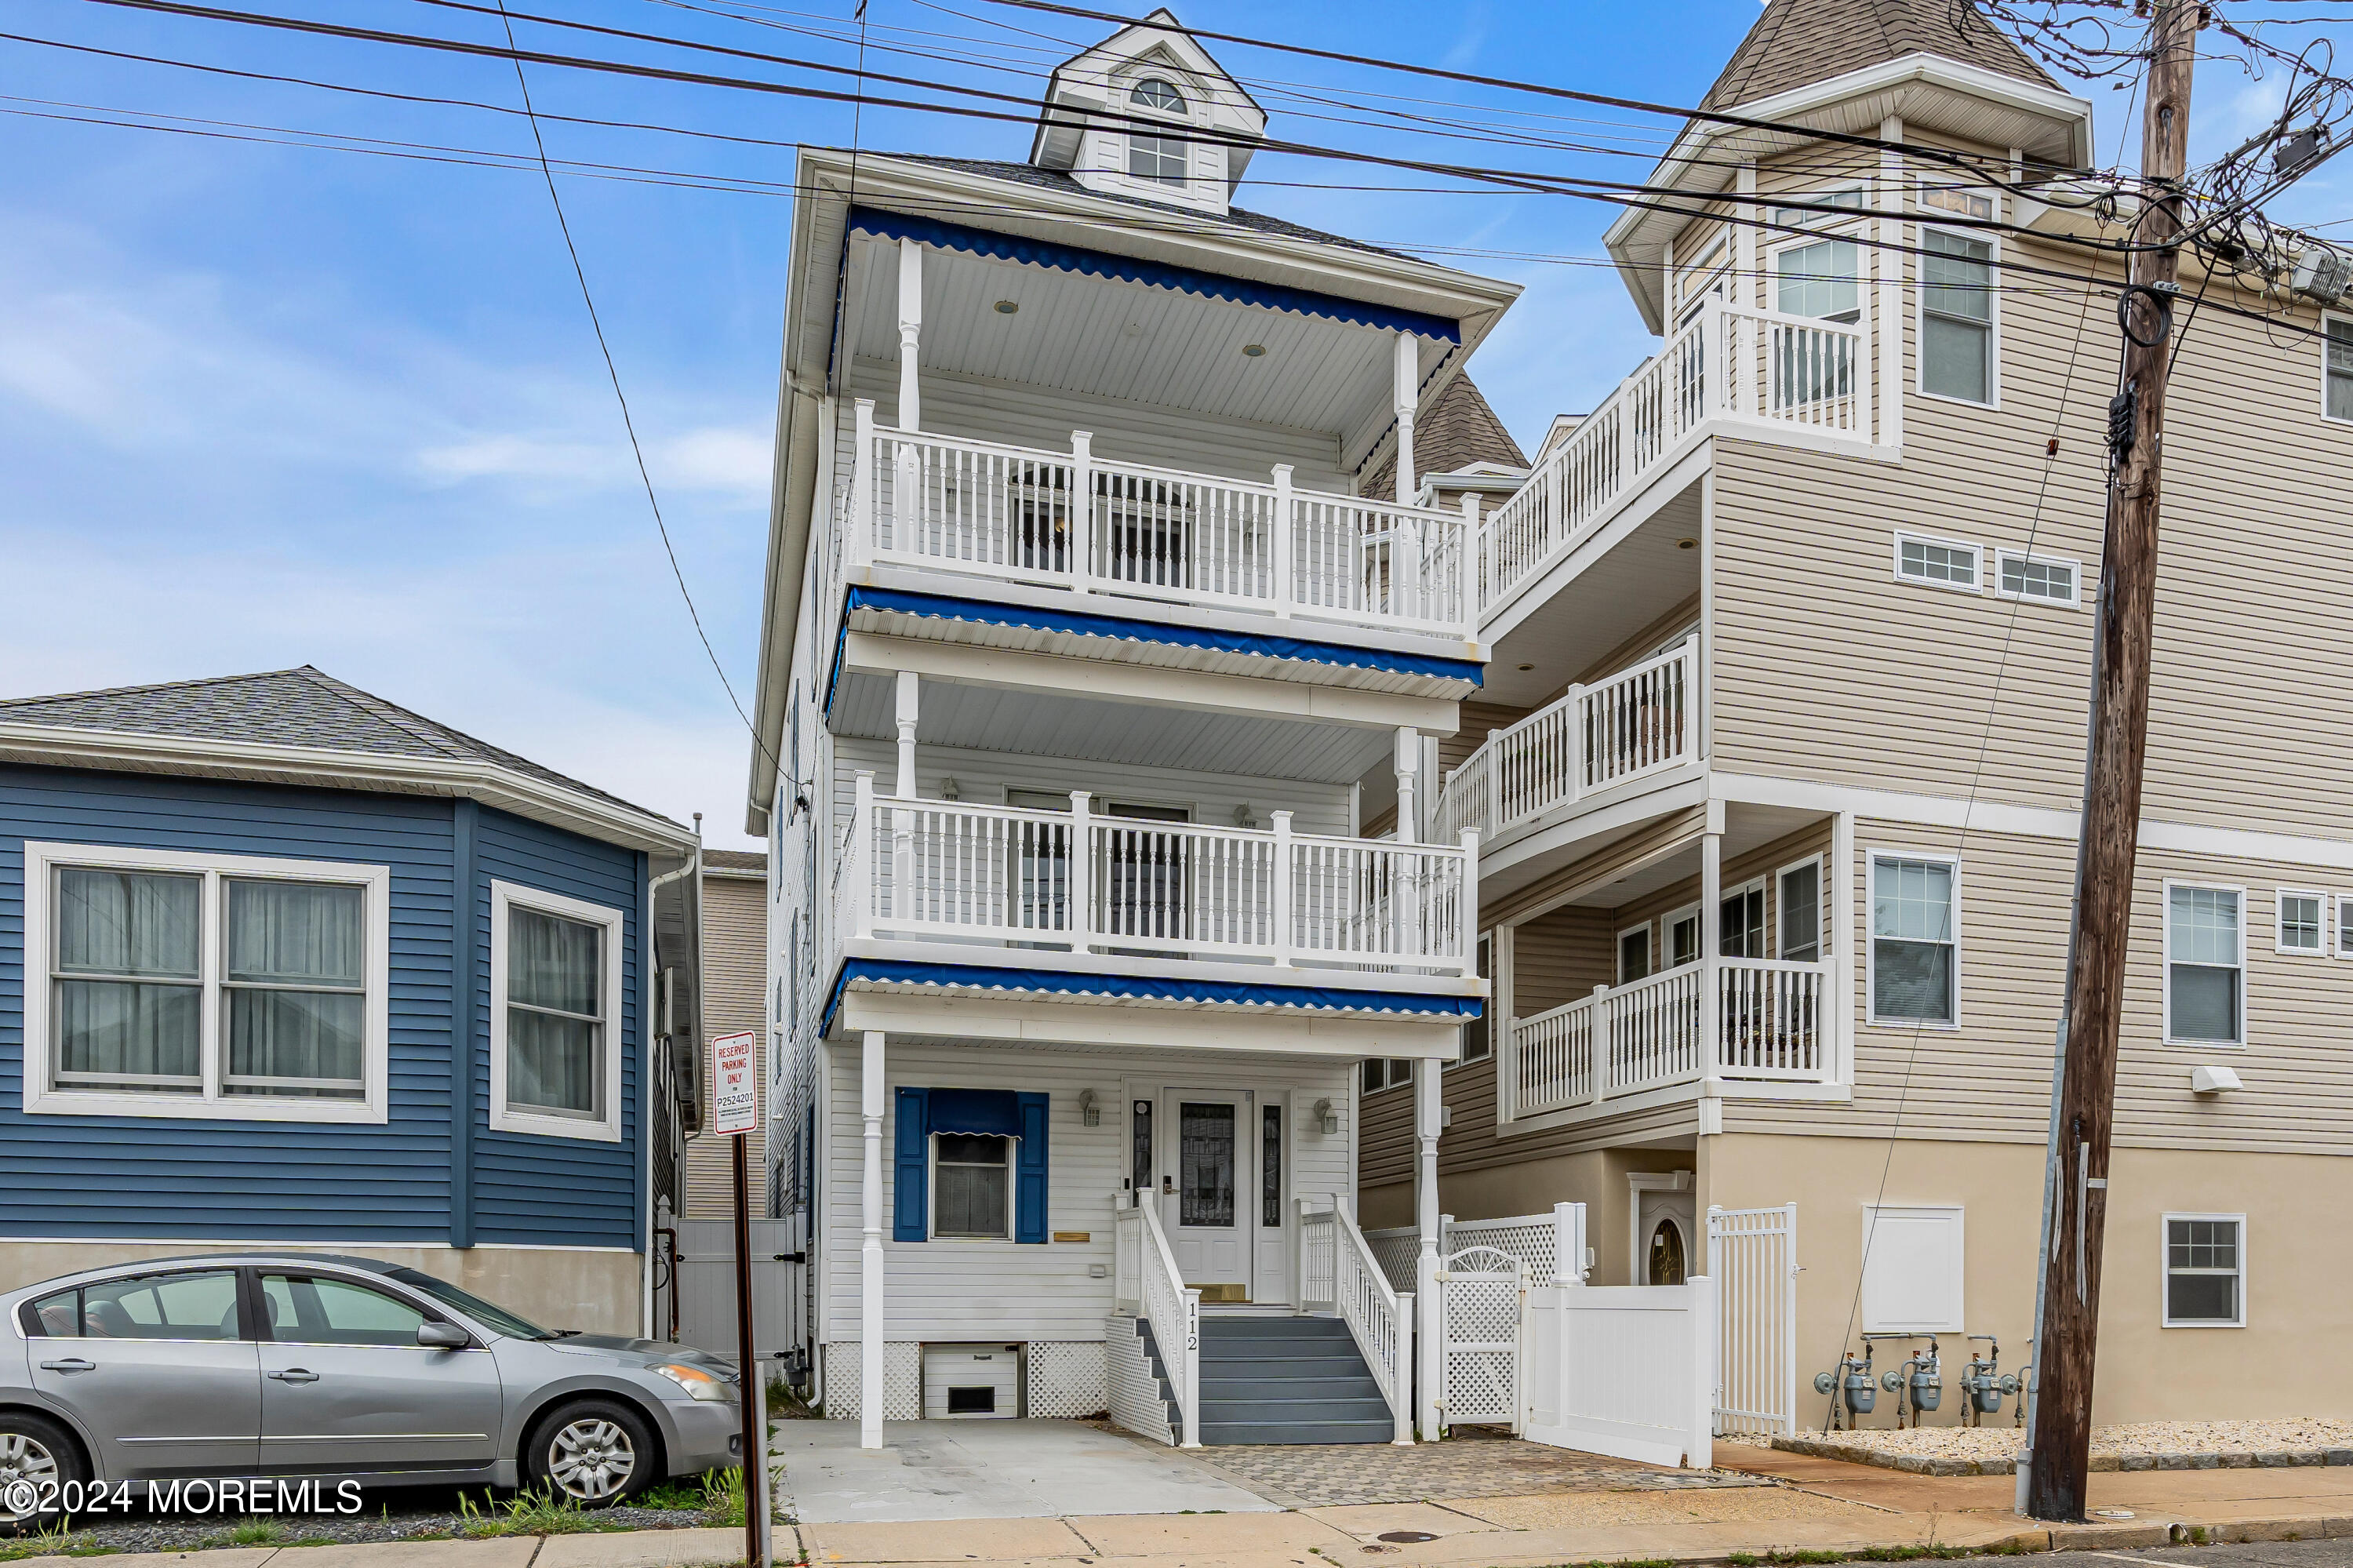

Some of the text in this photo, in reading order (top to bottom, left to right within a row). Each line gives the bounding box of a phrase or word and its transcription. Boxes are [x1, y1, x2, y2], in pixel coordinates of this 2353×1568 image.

[718, 1044, 749, 1058] RESERVED
[722, 1058, 747, 1071] PARKING
[727, 1072, 742, 1084] ONLY
[717, 1093, 754, 1107] P2524201
